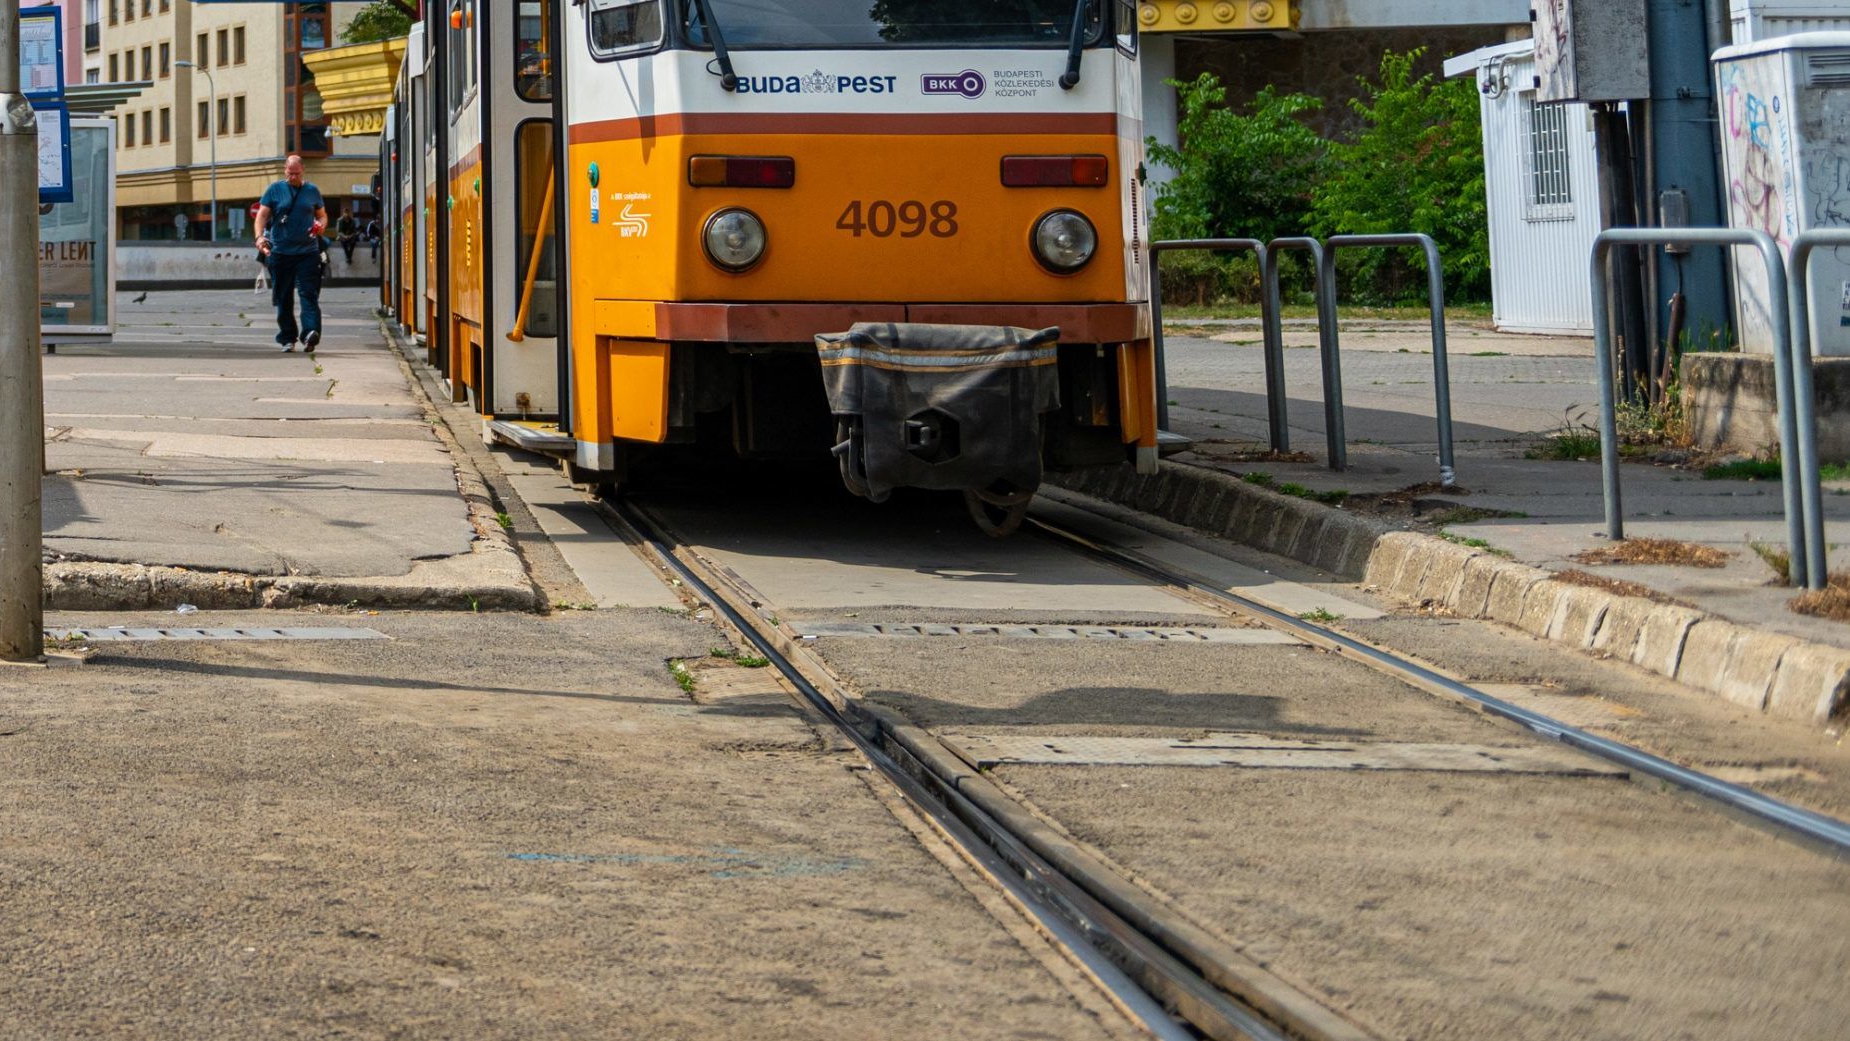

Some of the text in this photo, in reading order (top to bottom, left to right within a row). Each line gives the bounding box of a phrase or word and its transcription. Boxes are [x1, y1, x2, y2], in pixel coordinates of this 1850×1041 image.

[993, 70, 1043, 79] BUDAPESTI
[929, 79, 958, 90] BKK
[994, 78, 1055, 88] KÖZLEKEDÉSI
[995, 88, 1037, 97] KÖZPONT
[836, 200, 958, 238] 4098
